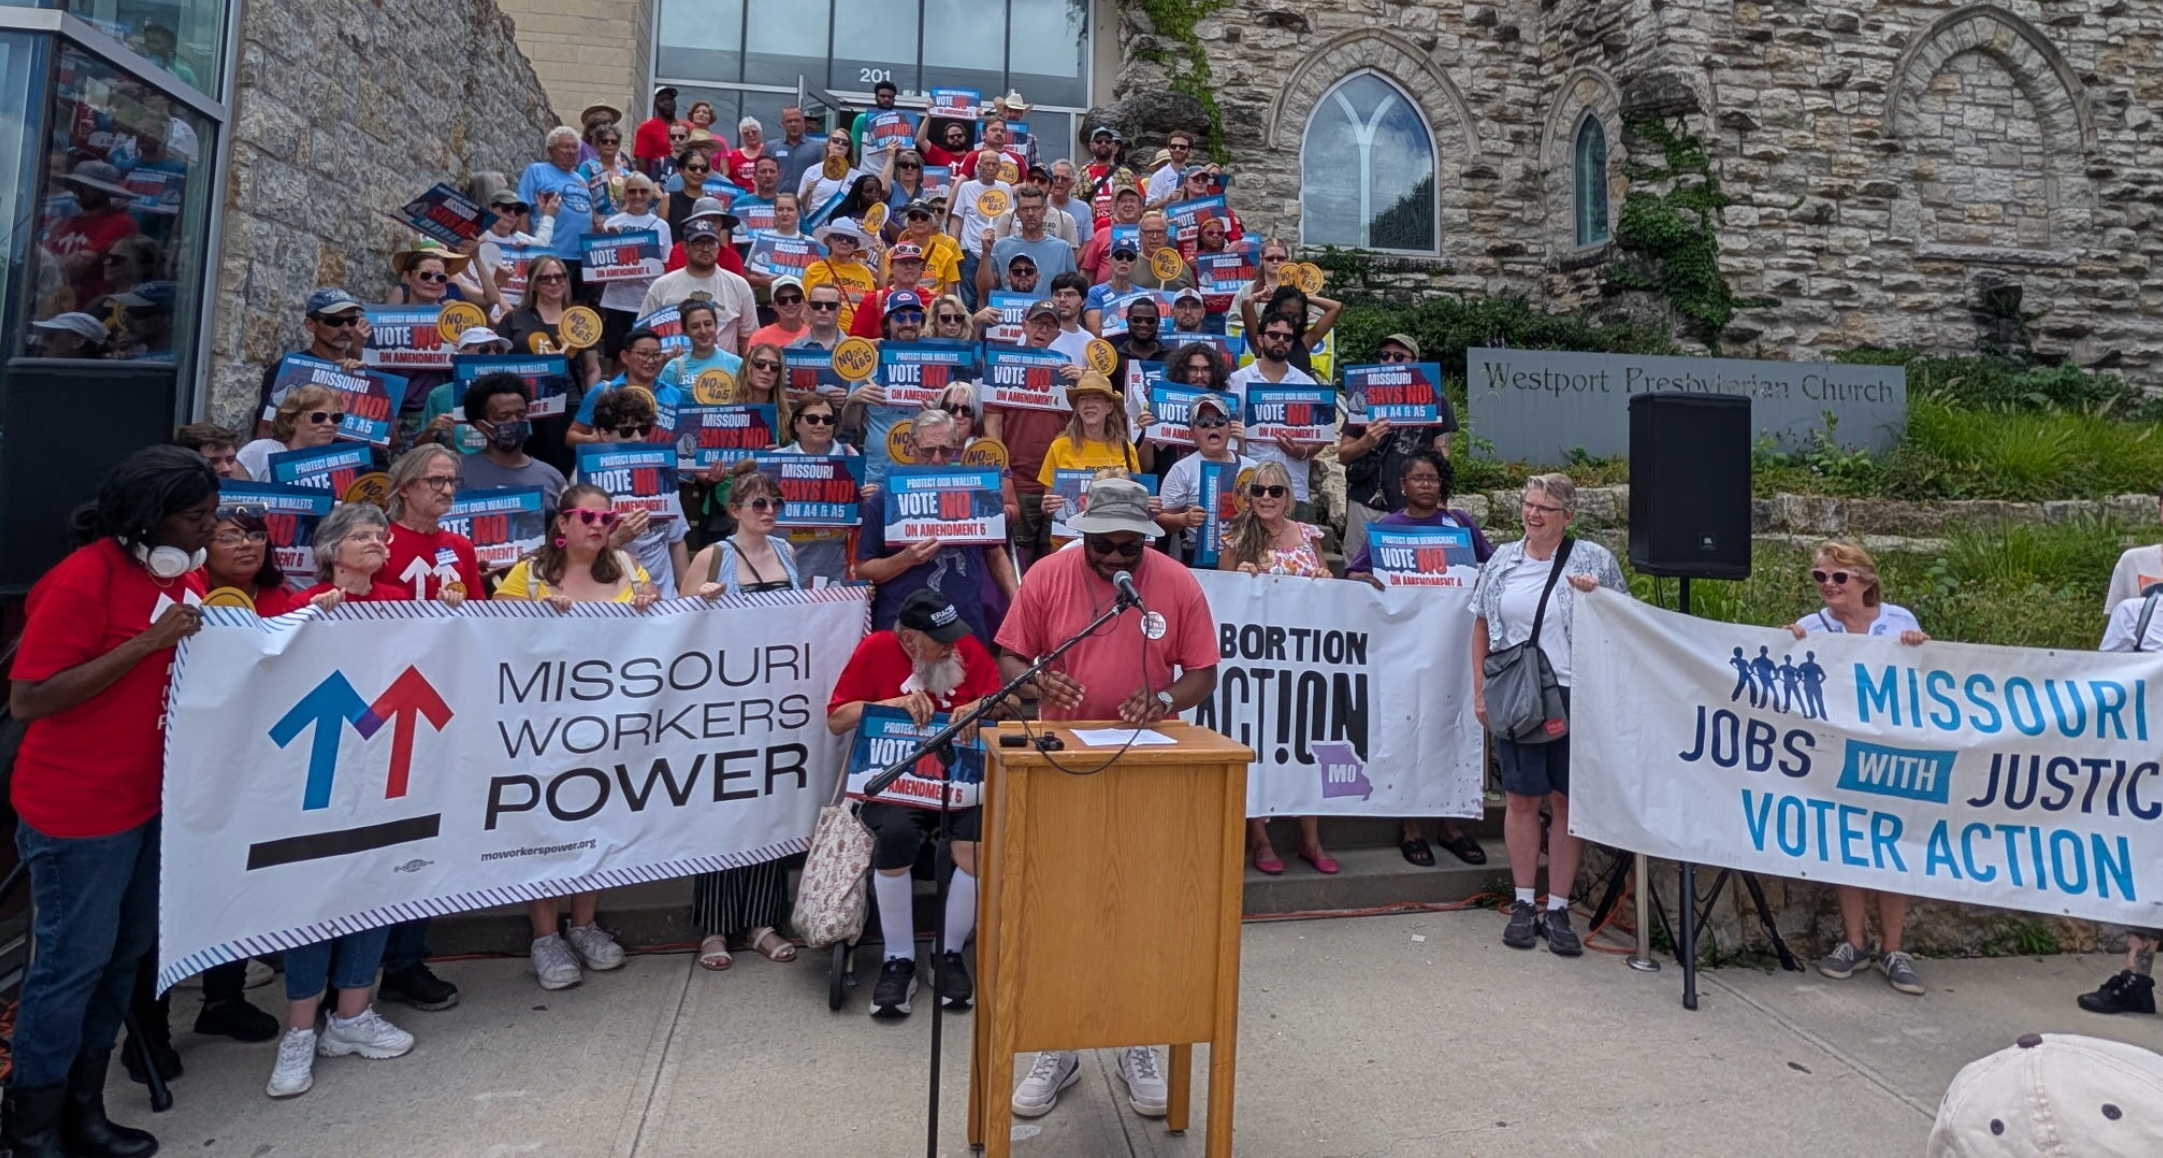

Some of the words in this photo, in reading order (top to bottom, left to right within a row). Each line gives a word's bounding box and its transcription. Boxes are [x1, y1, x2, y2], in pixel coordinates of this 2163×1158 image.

[859, 68, 892, 83] 201
[936, 96, 953, 106] VOTE
[982, 195, 994, 204] NO
[749, 209, 775, 217] MISSOU
[774, 242, 809, 254] MISSOURI
[589, 249, 618, 266] VOTE
[445, 312, 463, 326] NO
[569, 312, 586, 327] NO
[650, 310, 681, 327] MISSOU
[373, 326, 411, 346] VOTE
[379, 351, 392, 363] ON
[392, 350, 447, 363] AMENDMENT
[837, 351, 854, 368] NO
[310, 368, 371, 394] MISSOURI
[701, 377, 717, 388] NO
[888, 364, 920, 383] VOTE
[922, 364, 947, 387] NO
[994, 366, 1026, 385] VOTE
[1367, 372, 1412, 386] MISSOURI
[1483, 362, 1611, 398] Westport
[1624, 366, 1790, 401] Presbyterian
[1801, 373, 1894, 404] Church
[891, 390, 902, 400] ON
[1008, 391, 1053, 406] AMENDMENT
[1053, 395, 1059, 406] 4
[1367, 386, 1404, 404] SAYS
[1405, 384, 1434, 404] NO!
[353, 394, 391, 421] NO!
[1158, 402, 1188, 422] VOTE
[1255, 404, 1285, 421] VOTE
[1286, 403, 1311, 425] NO
[1374, 406, 1387, 417] ON
[1389, 406, 1402, 417] A4
[1413, 406, 1426, 417] A5
[344, 417, 354, 430] &
[356, 418, 374, 434] A5
[702, 413, 750, 428] MISSOURI
[700, 429, 741, 448] SAYS
[741, 427, 769, 449] NO!
[1161, 426, 1171, 437] ON
[1258, 427, 1269, 436] ON
[600, 455, 629, 467] PROTECT
[704, 451, 720, 462] ON
[722, 451, 735, 463] A4
[968, 450, 986, 461] NO
[295, 458, 327, 475] PROTECT
[326, 455, 339, 469] OUR
[781, 464, 834, 479] MISSOURI
[590, 468, 633, 494] VOTE
[907, 476, 936, 489] PROTECT
[937, 477, 951, 488] OUR
[951, 475, 982, 487] WALLETS
[779, 480, 823, 502] SAYS
[824, 479, 856, 502] NO!
[278, 497, 314, 509] WALLETS
[469, 500, 488, 512] OUR
[487, 497, 522, 511] WALLETS
[785, 504, 800, 517] ON
[803, 505, 817, 517] A4
[820, 505, 829, 517] &
[831, 505, 846, 518] A5
[897, 491, 939, 516] VOTE
[940, 490, 971, 520] NO
[264, 512, 297, 547] NO
[472, 512, 509, 545] NO
[905, 524, 920, 538] ON
[920, 522, 979, 537] AMENDMENT
[1382, 535, 1406, 544] PROTECT
[1406, 536, 1420, 545] OUR
[1419, 536, 1458, 545] DEMOCRACY
[1380, 547, 1416, 568] VOTE
[1416, 547, 1448, 575] NO
[1390, 574, 1401, 586] ON
[1402, 576, 1455, 586] AMENDMENT
[1219, 623, 1369, 666] BORTION
[498, 642, 811, 705] MISSOURI
[1853, 662, 2148, 742] MISSOURI
[497, 694, 810, 760] WORKERS
[1678, 704, 1817, 779] JOBS
[1856, 750, 1939, 793] WITH
[1967, 752, 2163, 821] JUSTIC
[1328, 763, 1357, 784] MO
[483, 742, 809, 831] POWER
[480, 838, 597, 862] moworkerspower.org
[1740, 787, 1909, 874] VOTER
[1924, 819, 2137, 902] ACTION
